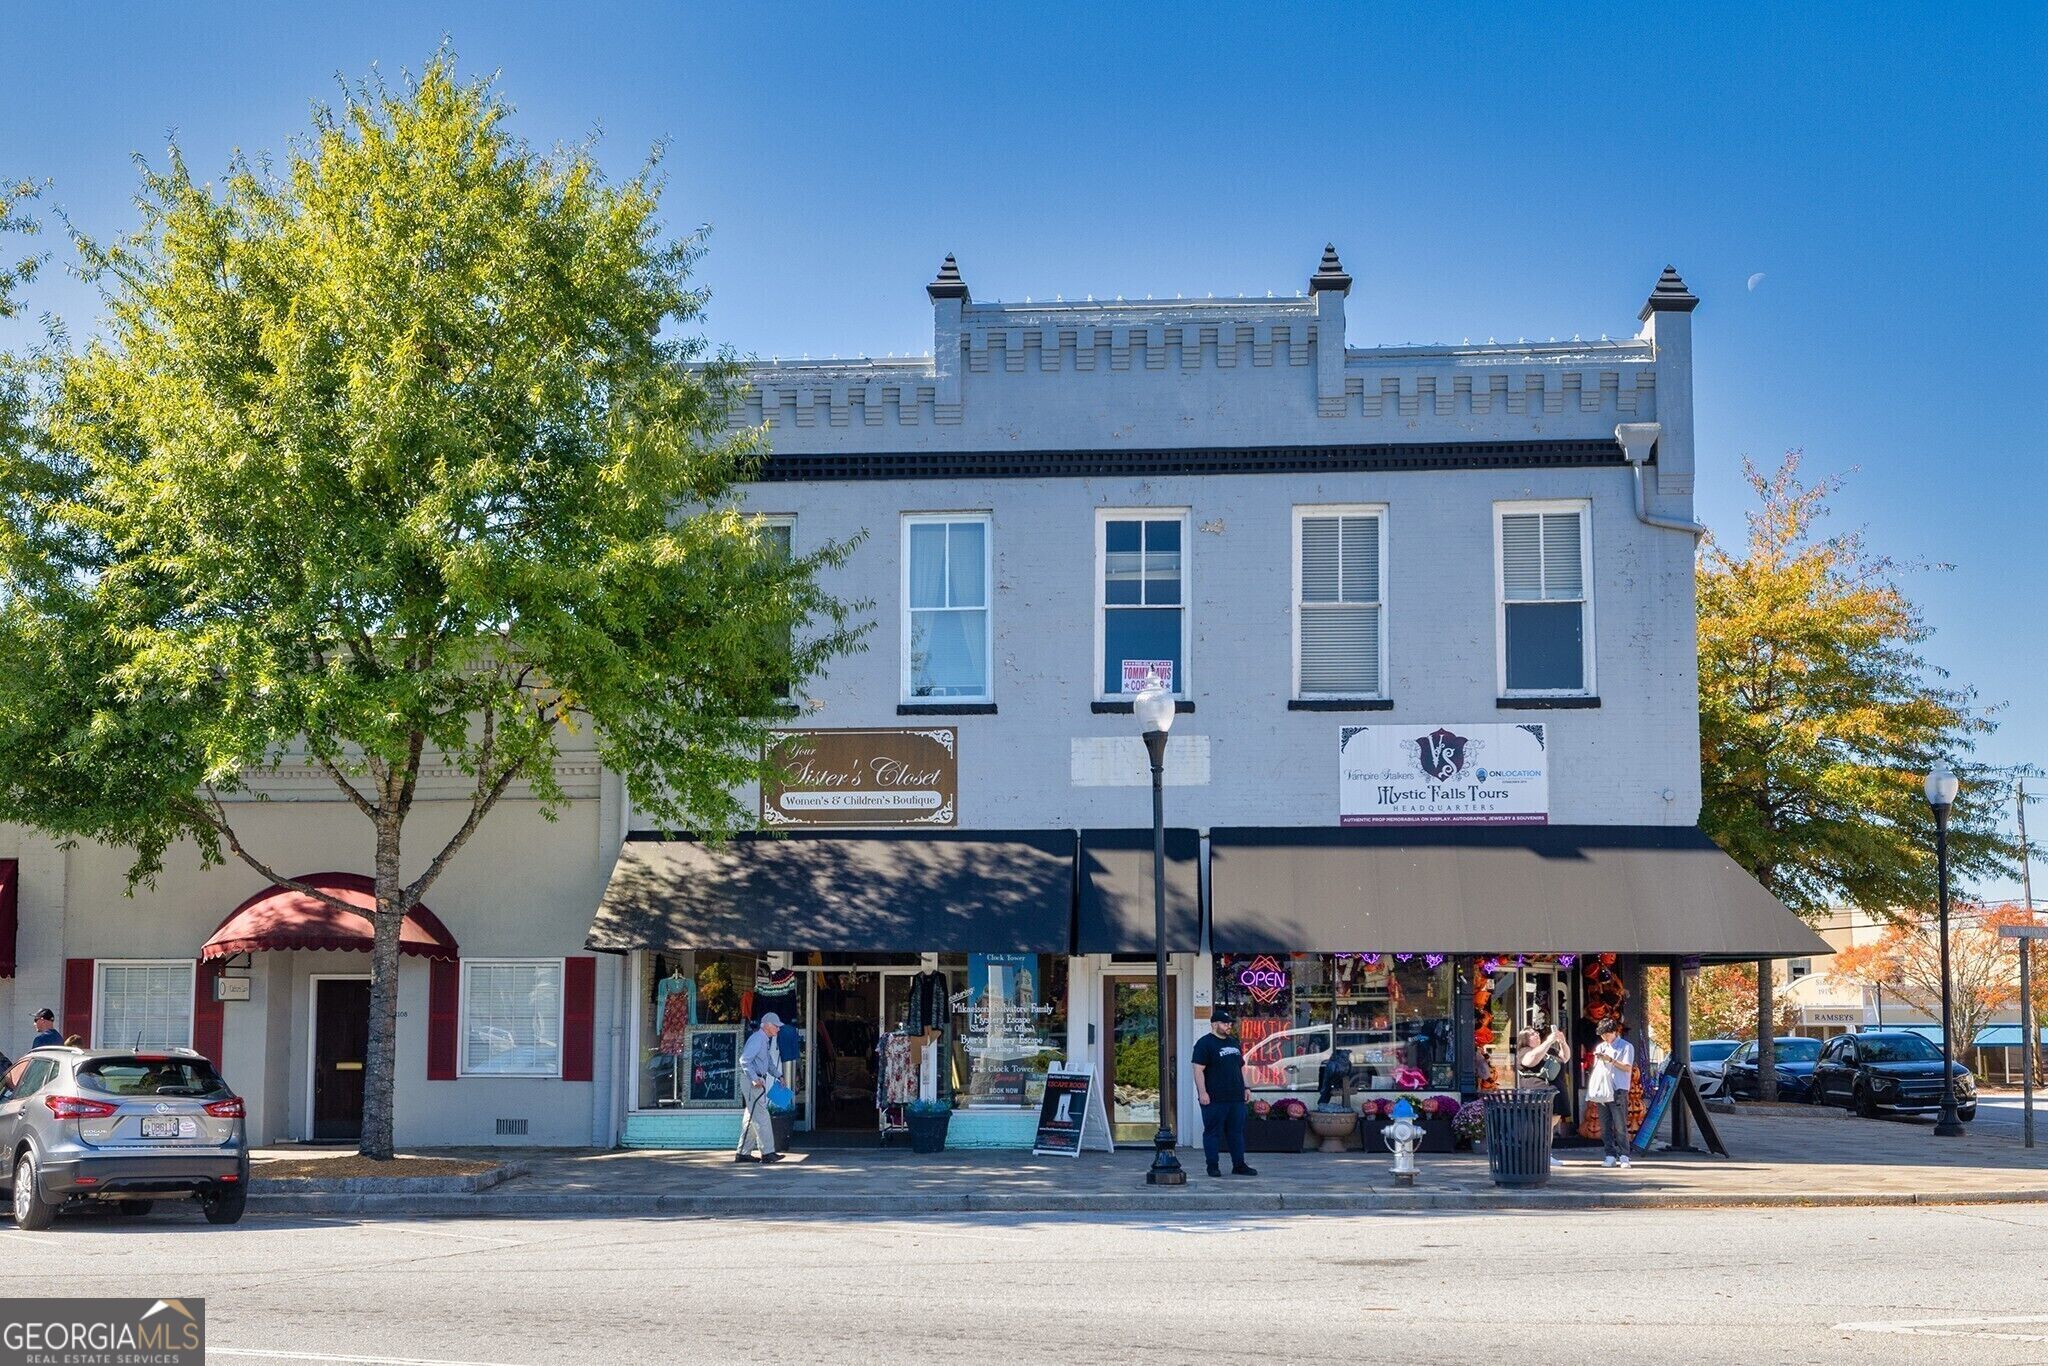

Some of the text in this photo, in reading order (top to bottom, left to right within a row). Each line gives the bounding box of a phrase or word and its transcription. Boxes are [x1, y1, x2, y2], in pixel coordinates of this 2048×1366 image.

[1124, 667, 1172, 680] TOMMY AVIS
[788, 744, 816, 760] Your
[781, 757, 942, 790] Sister's Closet
[1344, 768, 1415, 781] Vampire Stalkers
[786, 795, 936, 806] Women's & Children's Boutique
[1377, 785, 1509, 805] Mystic Falls Tours
[1393, 804, 1495, 812] HEADQUARTERS
[1240, 970, 1286, 988] OPEN
[1030, 1002, 1054, 1015] Family
[1006, 1014, 1031, 1026] Escape
[1241, 1019, 1291, 1040] MYSTIC
[1019, 1034, 1043, 1045] Escape
[1243, 1041, 1283, 1061] FALLS
[988, 1065, 1009, 1073] Clock
[1011, 1065, 1035, 1073] Tower
[1243, 1065, 1287, 1086] TOURS
[1048, 1081, 1087, 1089] ESCAPE ROOM
